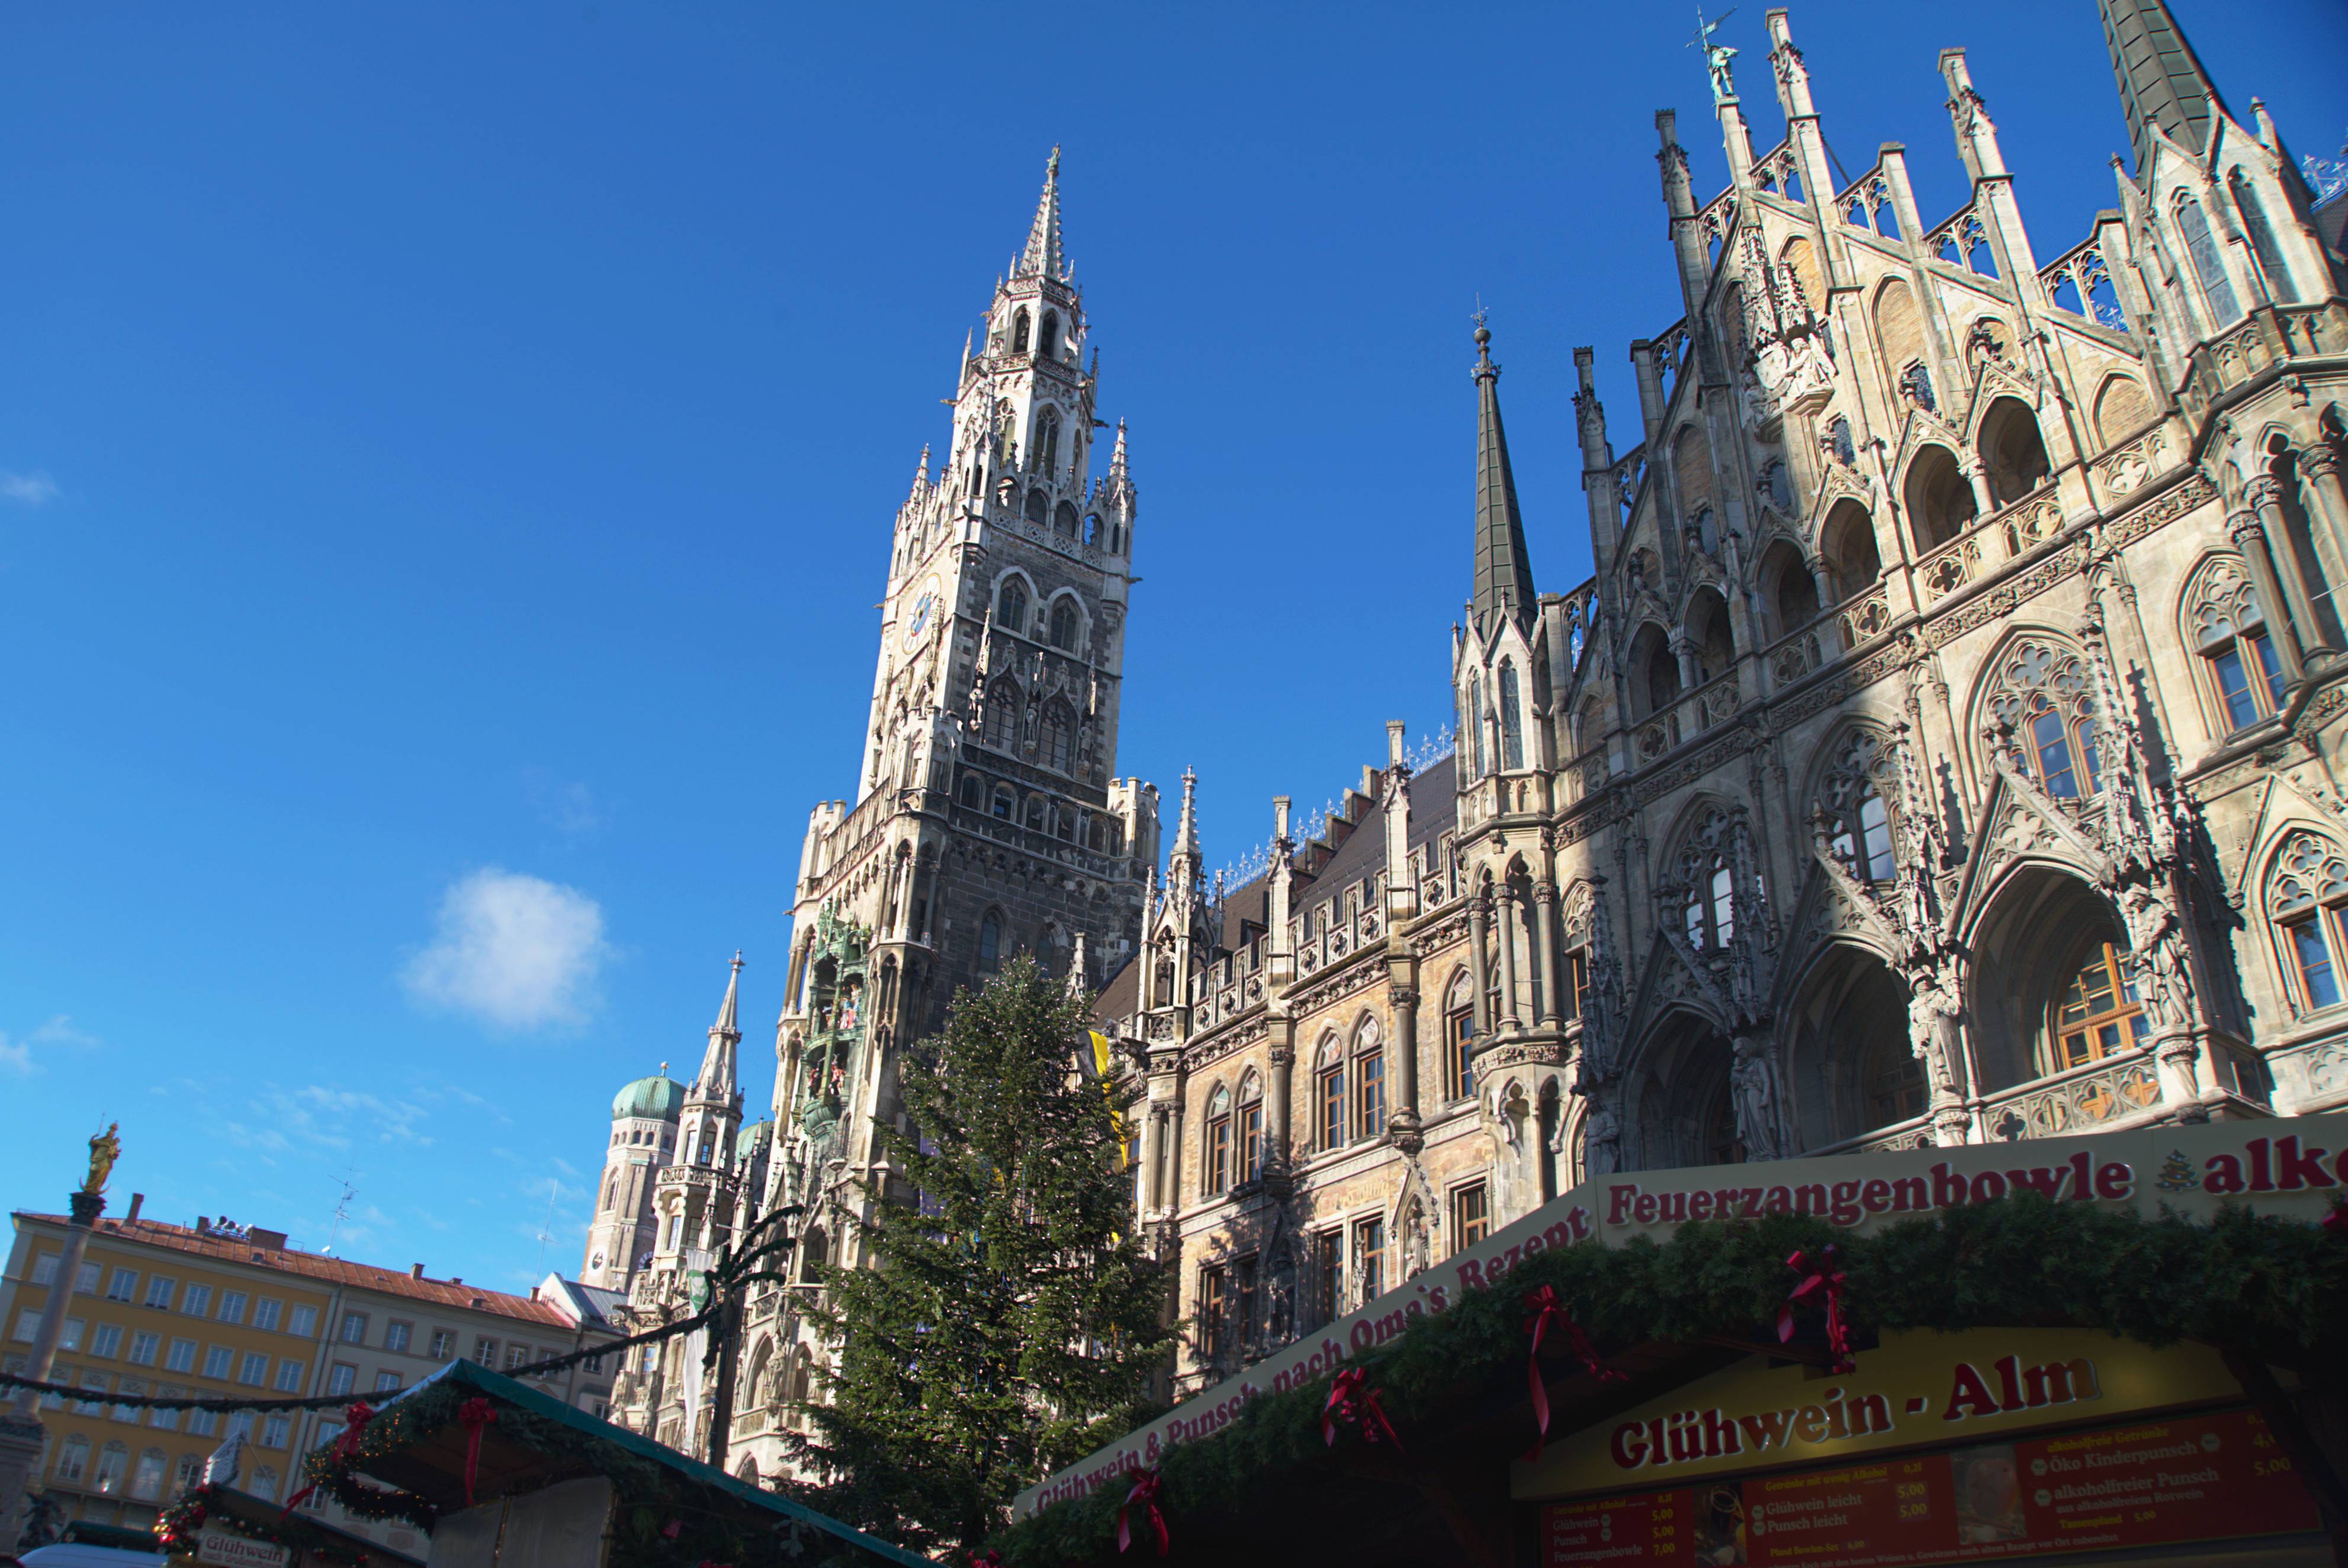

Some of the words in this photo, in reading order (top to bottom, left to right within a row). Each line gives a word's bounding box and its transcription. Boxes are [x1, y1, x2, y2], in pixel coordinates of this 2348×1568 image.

[2204, 1135, 2348, 1194] alk
[1607, 1151, 2132, 1226] Feuerzangenbowle
[1038, 1450, 1139, 1510] Glühwein
[1146, 1432, 1162, 1463] &
[1167, 1382, 1260, 1443] Punsch
[1273, 1338, 1342, 1392] nach
[1456, 1206, 1589, 1291] Rezept
[1610, 1387, 1894, 1470] Glühwein
[1943, 1355, 2102, 1422] Alm
[2047, 1434, 2113, 1453] alkoholfreie
[2115, 1426, 2170, 1444] Getränke
[2050, 1455, 2082, 1473] Öko
[2084, 1441, 2198, 1469] Kinderpunsch
[1807, 1477, 1820, 1486] mit
[1852, 1467, 1887, 1480] Alkohol
[2054, 1477, 2154, 1499] alkoholfreier
[2157, 1467, 2220, 1488] Punsch
[2254, 1457, 2292, 1477] 5,00
[1766, 1498, 1825, 1516] Glühwein
[1827, 1493, 1863, 1508] leicht
[1897, 1483, 1925, 1499] 5,00
[2056, 1505, 2075, 1514] aus
[2077, 1495, 2153, 1511] alkoholfreiem
[2154, 1488, 2205, 1503] Rotwein
[1553, 1516, 1599, 1531] Glühwein
[1652, 1508, 1674, 1522] 5,00
[1766, 1518, 1810, 1533] Punsch
[1813, 1514, 1848, 1528] leicht
[1899, 1503, 1928, 1518] 5,00
[2059, 1515, 2123, 1529] Tassenpfand
[207, 1536, 284, 1562] Glühwein
[1553, 1532, 1588, 1547] Punsch
[1652, 1525, 1675, 1539] 5,00
[1554, 1544, 1643, 1563] Feuerzangenbowle
[1653, 1543, 1676, 1556] 7,00
